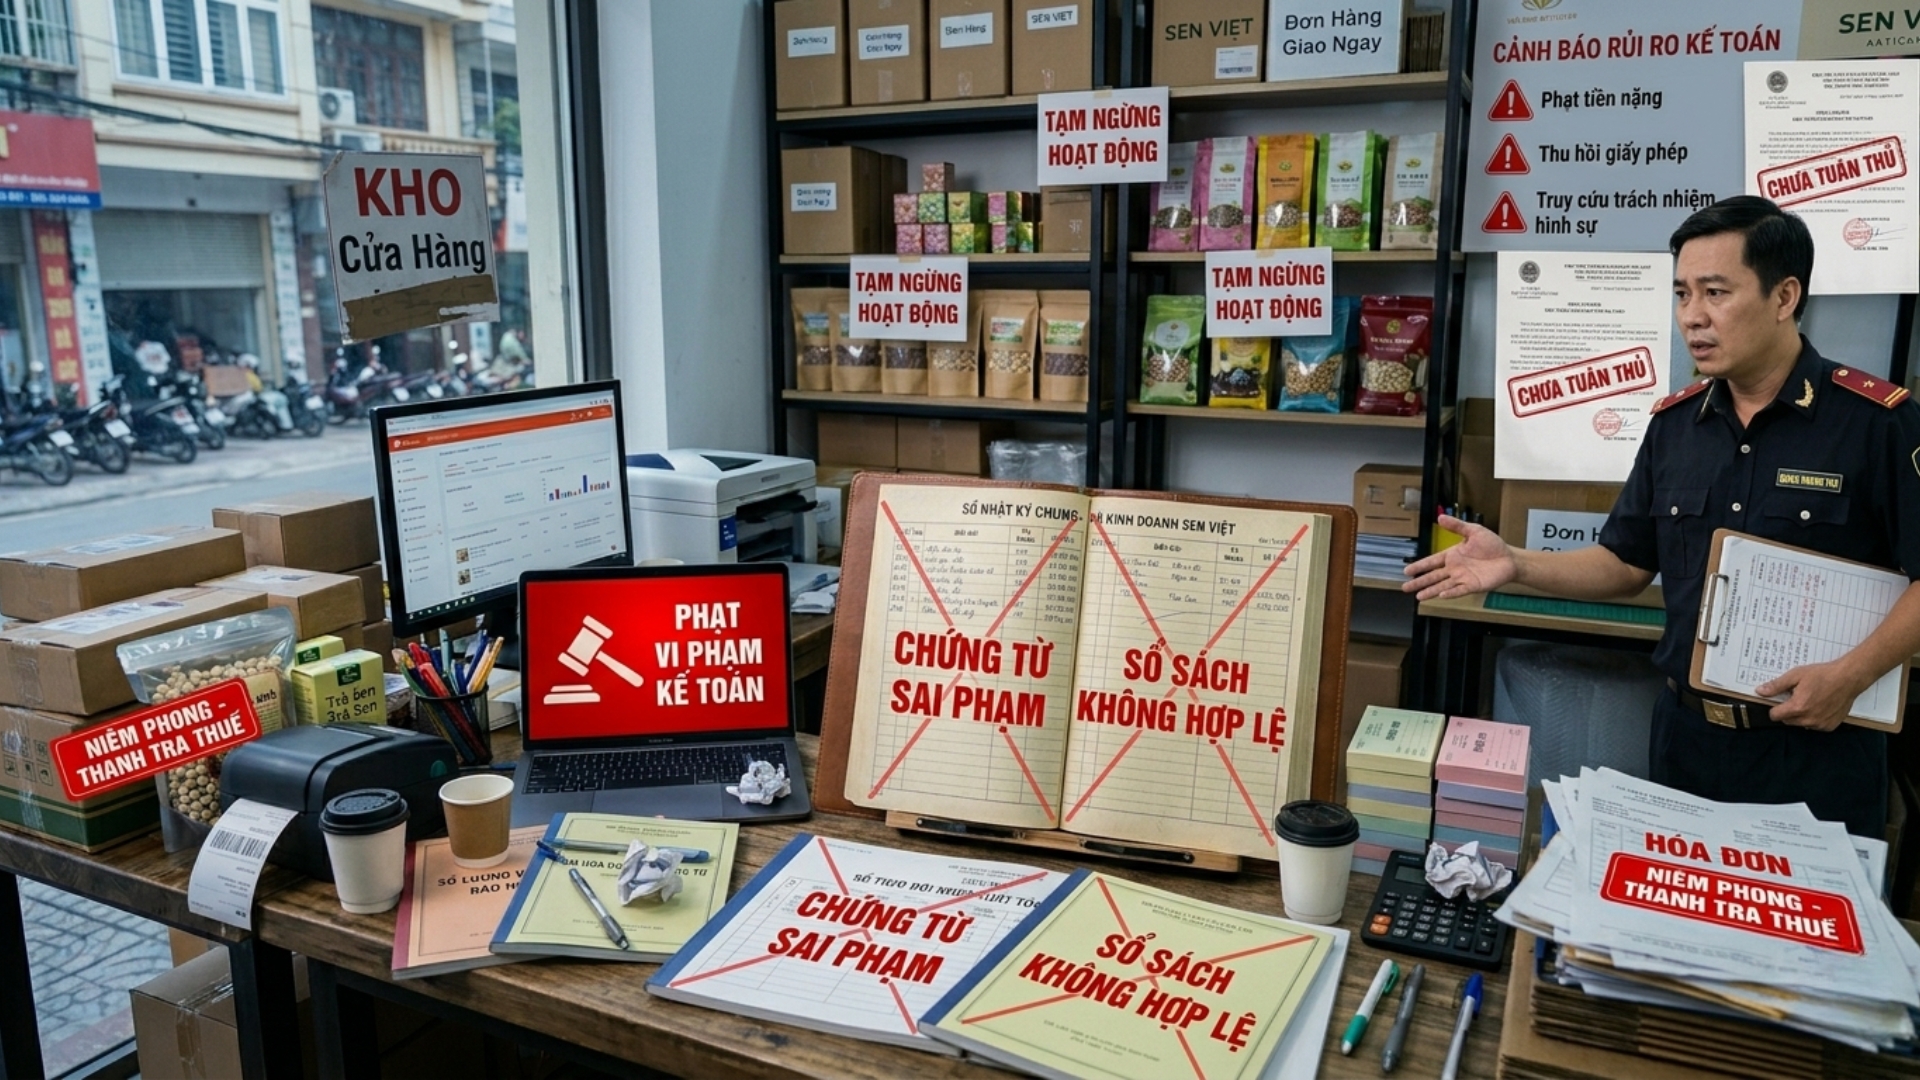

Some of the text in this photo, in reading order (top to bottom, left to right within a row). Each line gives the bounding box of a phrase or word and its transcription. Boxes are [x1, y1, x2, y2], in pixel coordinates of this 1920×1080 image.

[1165, 22, 1202, 41] SEN
[1284, 8, 1382, 30] Đơn Hàng
[1839, 11, 1894, 34] SEN
[1283, 35, 1382, 55] Giao Ngay
[1493, 24, 1780, 63] CẢNH BÁO RỦI RO KẾ TOÁN
[1542, 87, 1662, 112] Phạt tiền nặng
[1045, 102, 1161, 136] TẠM NGỪNG
[1048, 143, 1098, 170] HOẠT
[1539, 141, 1688, 165] Thu hồi giấy phép
[354, 167, 462, 217] KHO
[1536, 189, 1715, 212] Truy cứu trách nhiệm
[1576, 219, 1598, 238] sự
[339, 231, 486, 275] Cửa Hàng
[855, 268, 962, 296] TẠM NGỪNG
[1212, 261, 1325, 292] TẠM NGỪNG
[858, 303, 904, 327] HOẠT
[1216, 294, 1322, 324] HOẠT ĐỘNG
[1106, 512, 1133, 526] KINH
[1137, 515, 1179, 530] DOANH
[1542, 523, 1584, 541] Đơn
[675, 601, 741, 635] PHẠT
[654, 638, 763, 671] VI PHẠM
[894, 628, 1055, 679] CHỨNG TỪ
[1123, 636, 1250, 694] SỔ SÁCH
[656, 669, 764, 706] KẾ TOÁN
[353, 701, 377, 717] Sen
[890, 679, 1047, 734] SAI PHẠM
[1076, 688, 1287, 753] KHÔNG HỢP LỆ
[84, 725, 139, 759] NIÊM
[141, 700, 213, 740] PHONG
[76, 709, 245, 787] THANH TRA THUẾ
[1645, 832, 1792, 877] HÓA ĐƠN
[1624, 881, 1839, 940] THANH TRA THUẾ
[1717, 879, 1803, 912] PHONG
[796, 891, 919, 936] CHỨNG
[926, 910, 975, 944] TỪ
[767, 927, 945, 985] SAI PHẠM
[1096, 932, 1236, 995] SỔ SÁCH
[1018, 952, 1138, 1010] KHÔNG
[1137, 988, 1210, 1031] HỢP
[1210, 1011, 1257, 1053] LỆ
